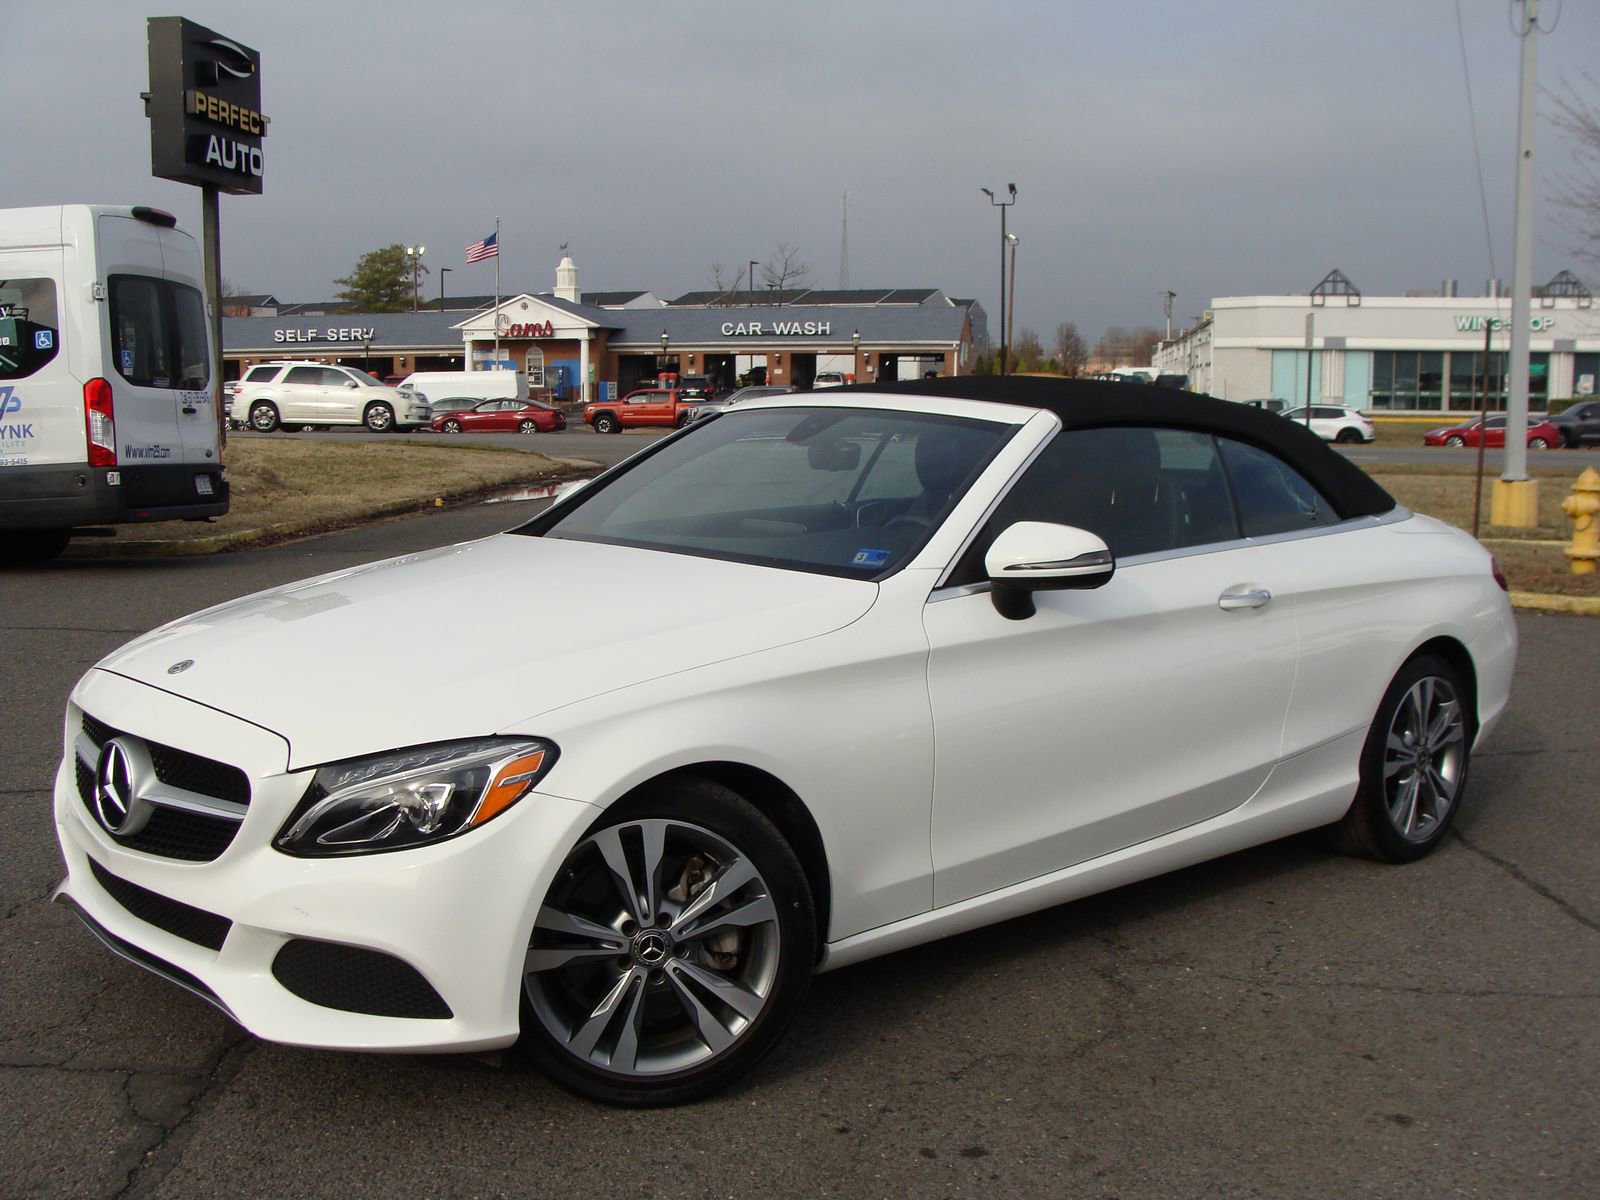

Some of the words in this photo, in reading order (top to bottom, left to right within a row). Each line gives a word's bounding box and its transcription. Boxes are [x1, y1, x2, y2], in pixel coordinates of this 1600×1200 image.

[195, 90, 271, 137] PERFECT
[206, 134, 264, 177] AUTO
[274, 329, 318, 342] SELF
[327, 328, 375, 341] SERV
[721, 322, 762, 336] CAR
[772, 321, 831, 335] WASH
